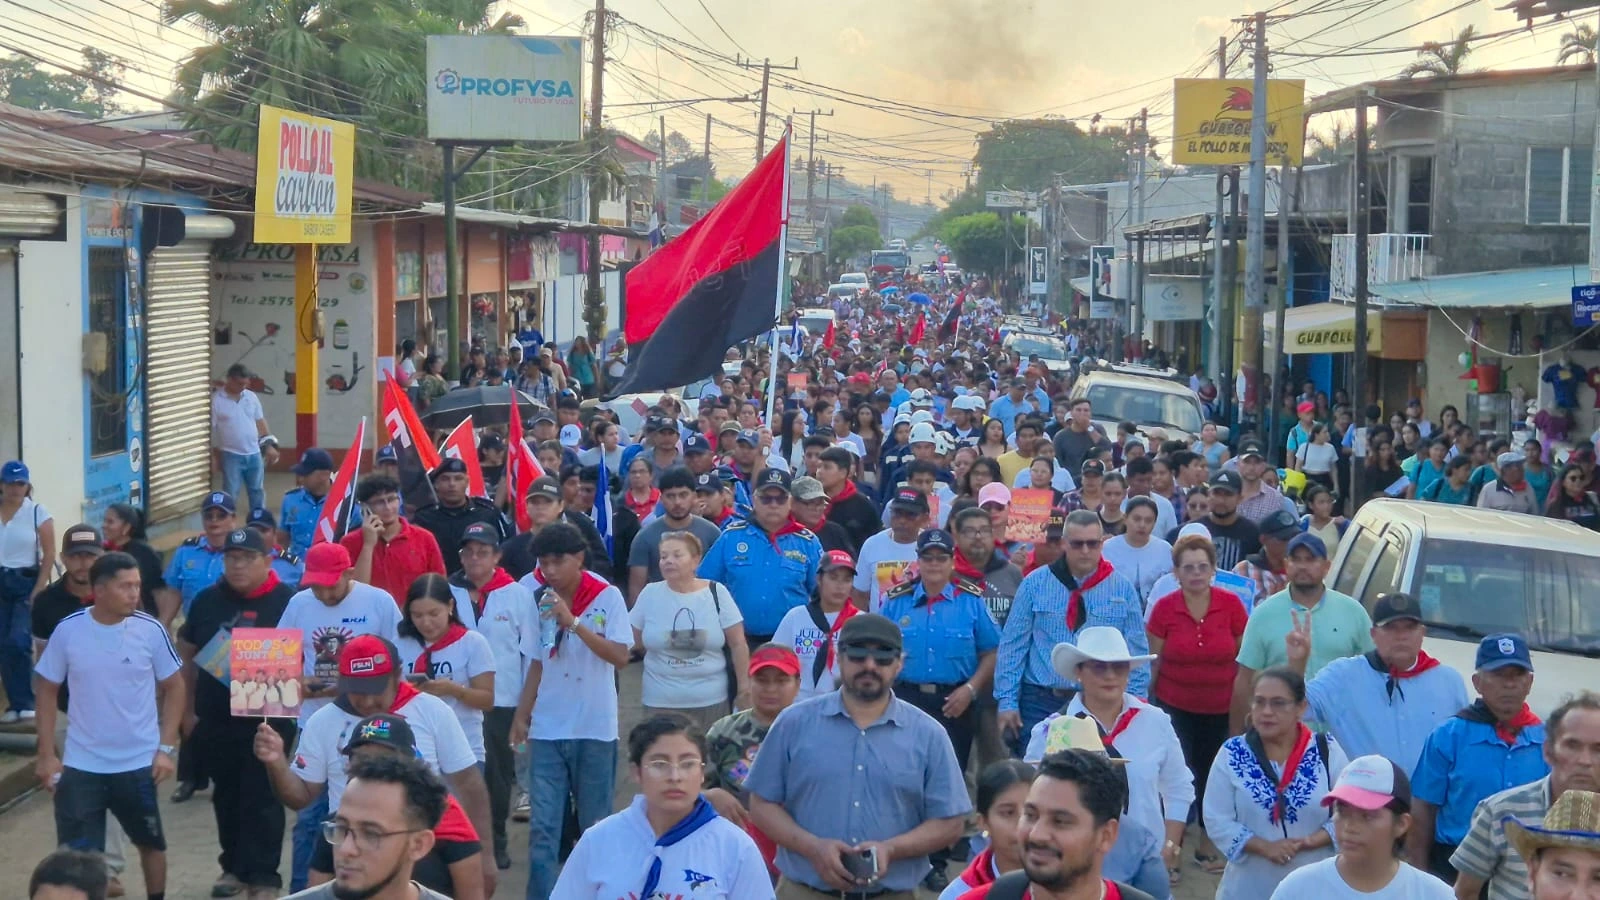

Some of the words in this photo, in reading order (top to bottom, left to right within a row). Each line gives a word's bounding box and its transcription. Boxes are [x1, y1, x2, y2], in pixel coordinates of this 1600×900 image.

[460, 77, 574, 98] PROFYSA
[280, 122, 318, 173] POLLO
[319, 129, 333, 175] AL
[1187, 142, 1198, 153] EL
[1199, 141, 1227, 154] POLLO
[1228, 141, 1240, 153] DE
[276, 160, 334, 214] carbon
[240, 243, 360, 262] PROYSA
[1577, 303, 1600, 312] Recar
[1297, 328, 1374, 344] GUAPOLLN
[796, 629, 839, 640] JULIN
[233, 639, 282, 651] TODOS
